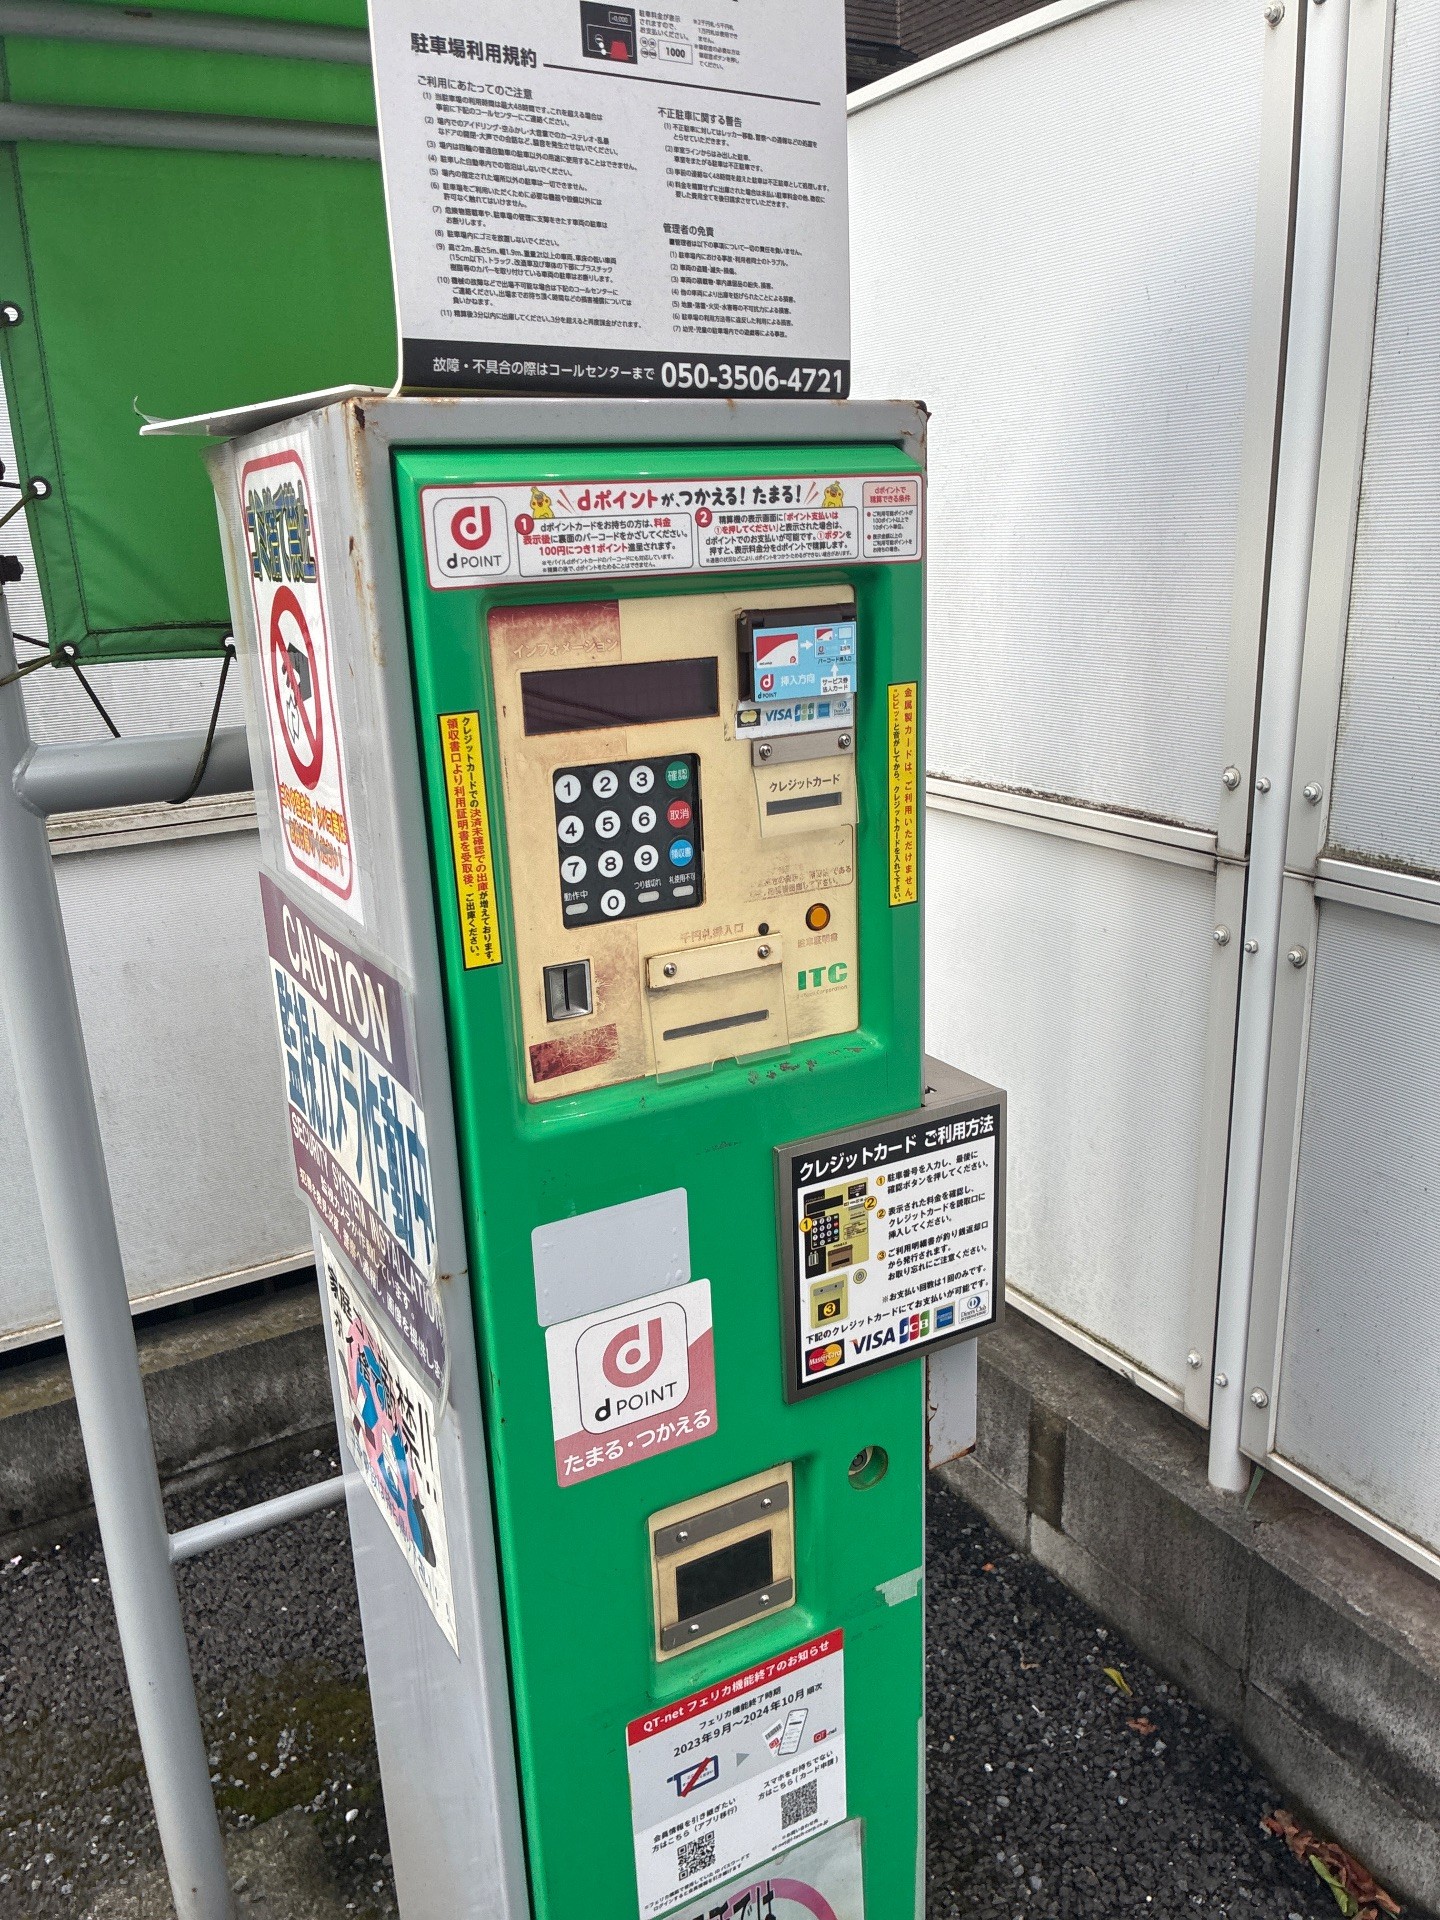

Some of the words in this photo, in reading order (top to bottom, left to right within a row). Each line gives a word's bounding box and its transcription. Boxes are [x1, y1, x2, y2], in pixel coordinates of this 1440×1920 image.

[411, 33, 537, 68] 駐車場利用規約
[666, 47, 685, 58] 1000
[418, 75, 532, 99] ご利用にあたってのご注意
[423, 92, 431, 100] (1)
[425, 116, 434, 124] (2)
[658, 107, 742, 128] 不正駐車に関する警告
[429, 168, 438, 176] (5)
[663, 223, 714, 237] 管理者の免責
[437, 276, 449, 284] (10)
[432, 357, 654, 382] 故障・不具合の際はコールセンターまで
[661, 361, 843, 393] 050-3506-4721
[462, 556, 501, 568] POINT
[781, 674, 815, 686] 挿入方向
[766, 709, 792, 721] VISA
[564, 781, 571, 796] 1
[600, 777, 611, 792] 2
[637, 772, 648, 787] 3
[770, 774, 840, 792] クレジットカード
[904, 687, 913, 900] 金属製カードは、ご利用いただけません。
[566, 822, 577, 836] 4
[602, 817, 613, 831] 5
[639, 812, 649, 826] 6
[670, 808, 690, 820] 取消
[568, 862, 579, 877] 7
[605, 857, 616, 871] 8
[641, 852, 652, 865] 9
[564, 890, 588, 901] 動作中
[608, 896, 619, 910] 0
[283, 904, 393, 1065] CAUTION
[798, 962, 847, 990] ITC
[274, 966, 434, 1268] 監視カメラ作動中
[799, 1134, 917, 1181] クレジットカード
[924, 1115, 994, 1147] ご利用方法
[291, 1111, 328, 1178] SECURITY
[332, 1162, 366, 1227] SYSTEM
[887, 1150, 978, 1182] 駐車番号を入力し、最後に
[887, 1160, 990, 1195] 確認ボタンを押してください。
[888, 1185, 975, 1217] 表示された料金を確認し、
[888, 1193, 986, 1228] クレジットカードを読取口に
[888, 1213, 953, 1240] 挿入してください。
[888, 1221, 988, 1258] ご利用明細書が釣り銭返却口
[887, 1244, 951, 1269] から発行されます。
[888, 1244, 988, 1281] お取り忘れにご注意ください。
[806, 1280, 988, 1344] 下記のクレジットカードにてお支払いが可能です。
[850, 1327, 895, 1354] VISA
[899, 1310, 930, 1344] JCB
[617, 1382, 677, 1415] POINT
[564, 1408, 710, 1475] たまる・つかえる
[644, 1707, 684, 1732] QT-net
[687, 1640, 829, 1712] フェリカ機能終了のお知らせ
[700, 1686, 781, 1730] フェリカ機能終了時期
[764, 1750, 834, 1789] スマホをお持ちでない
[653, 1799, 736, 1842] 会員情報を引き継ぎたい
